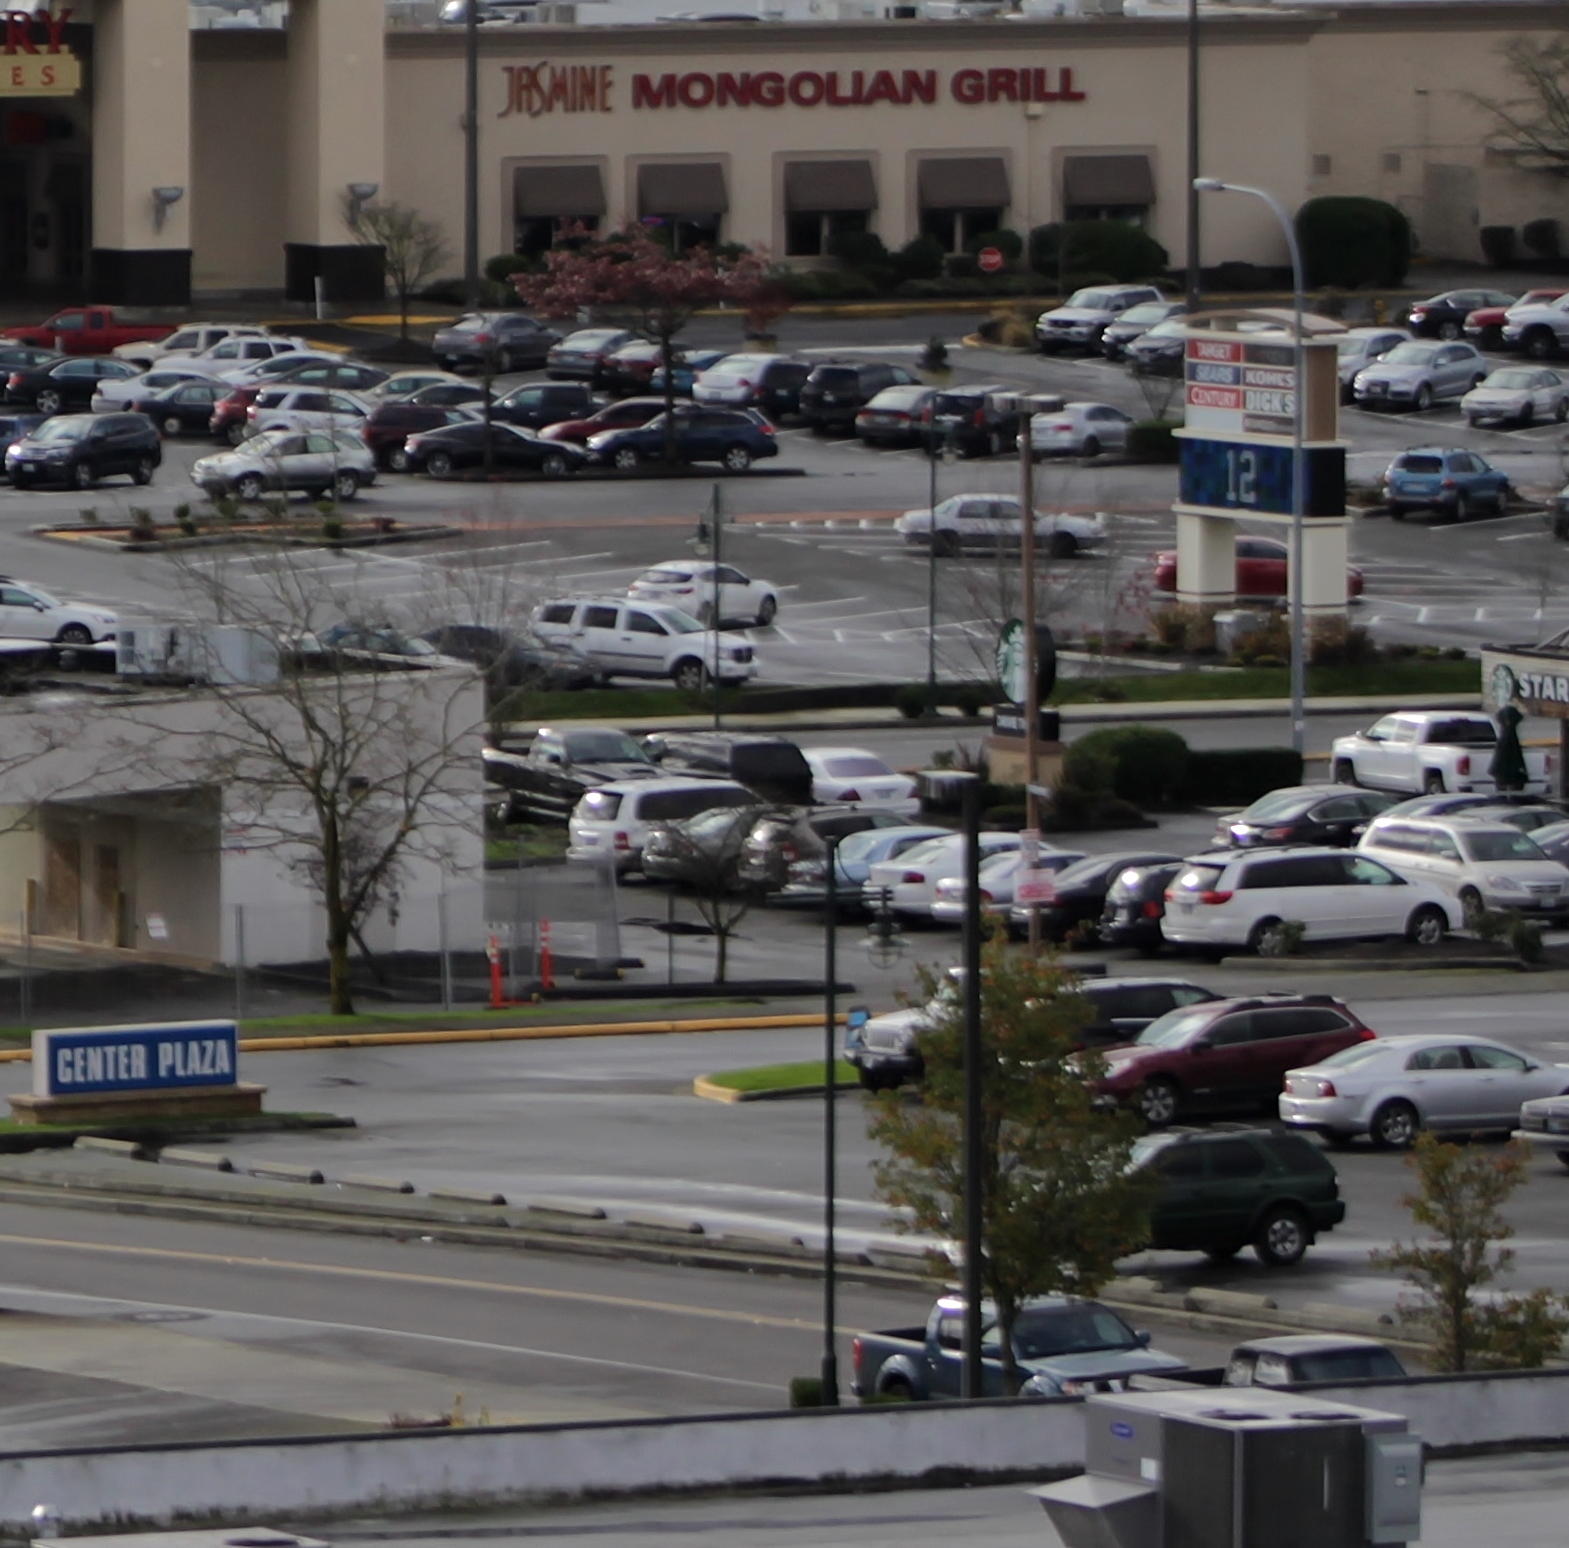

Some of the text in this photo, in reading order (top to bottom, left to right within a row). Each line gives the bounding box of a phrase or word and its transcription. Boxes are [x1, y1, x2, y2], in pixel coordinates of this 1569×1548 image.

[497, 60, 1087, 120] JASMINE MONGOLIAN GRILL
[1196, 340, 1232, 359] TARGET
[1195, 363, 1234, 384] SEARS
[1191, 386, 1237, 408] CENTURY
[1226, 450, 1257, 503] 12
[57, 1038, 231, 1084] CENTER PLAZA
